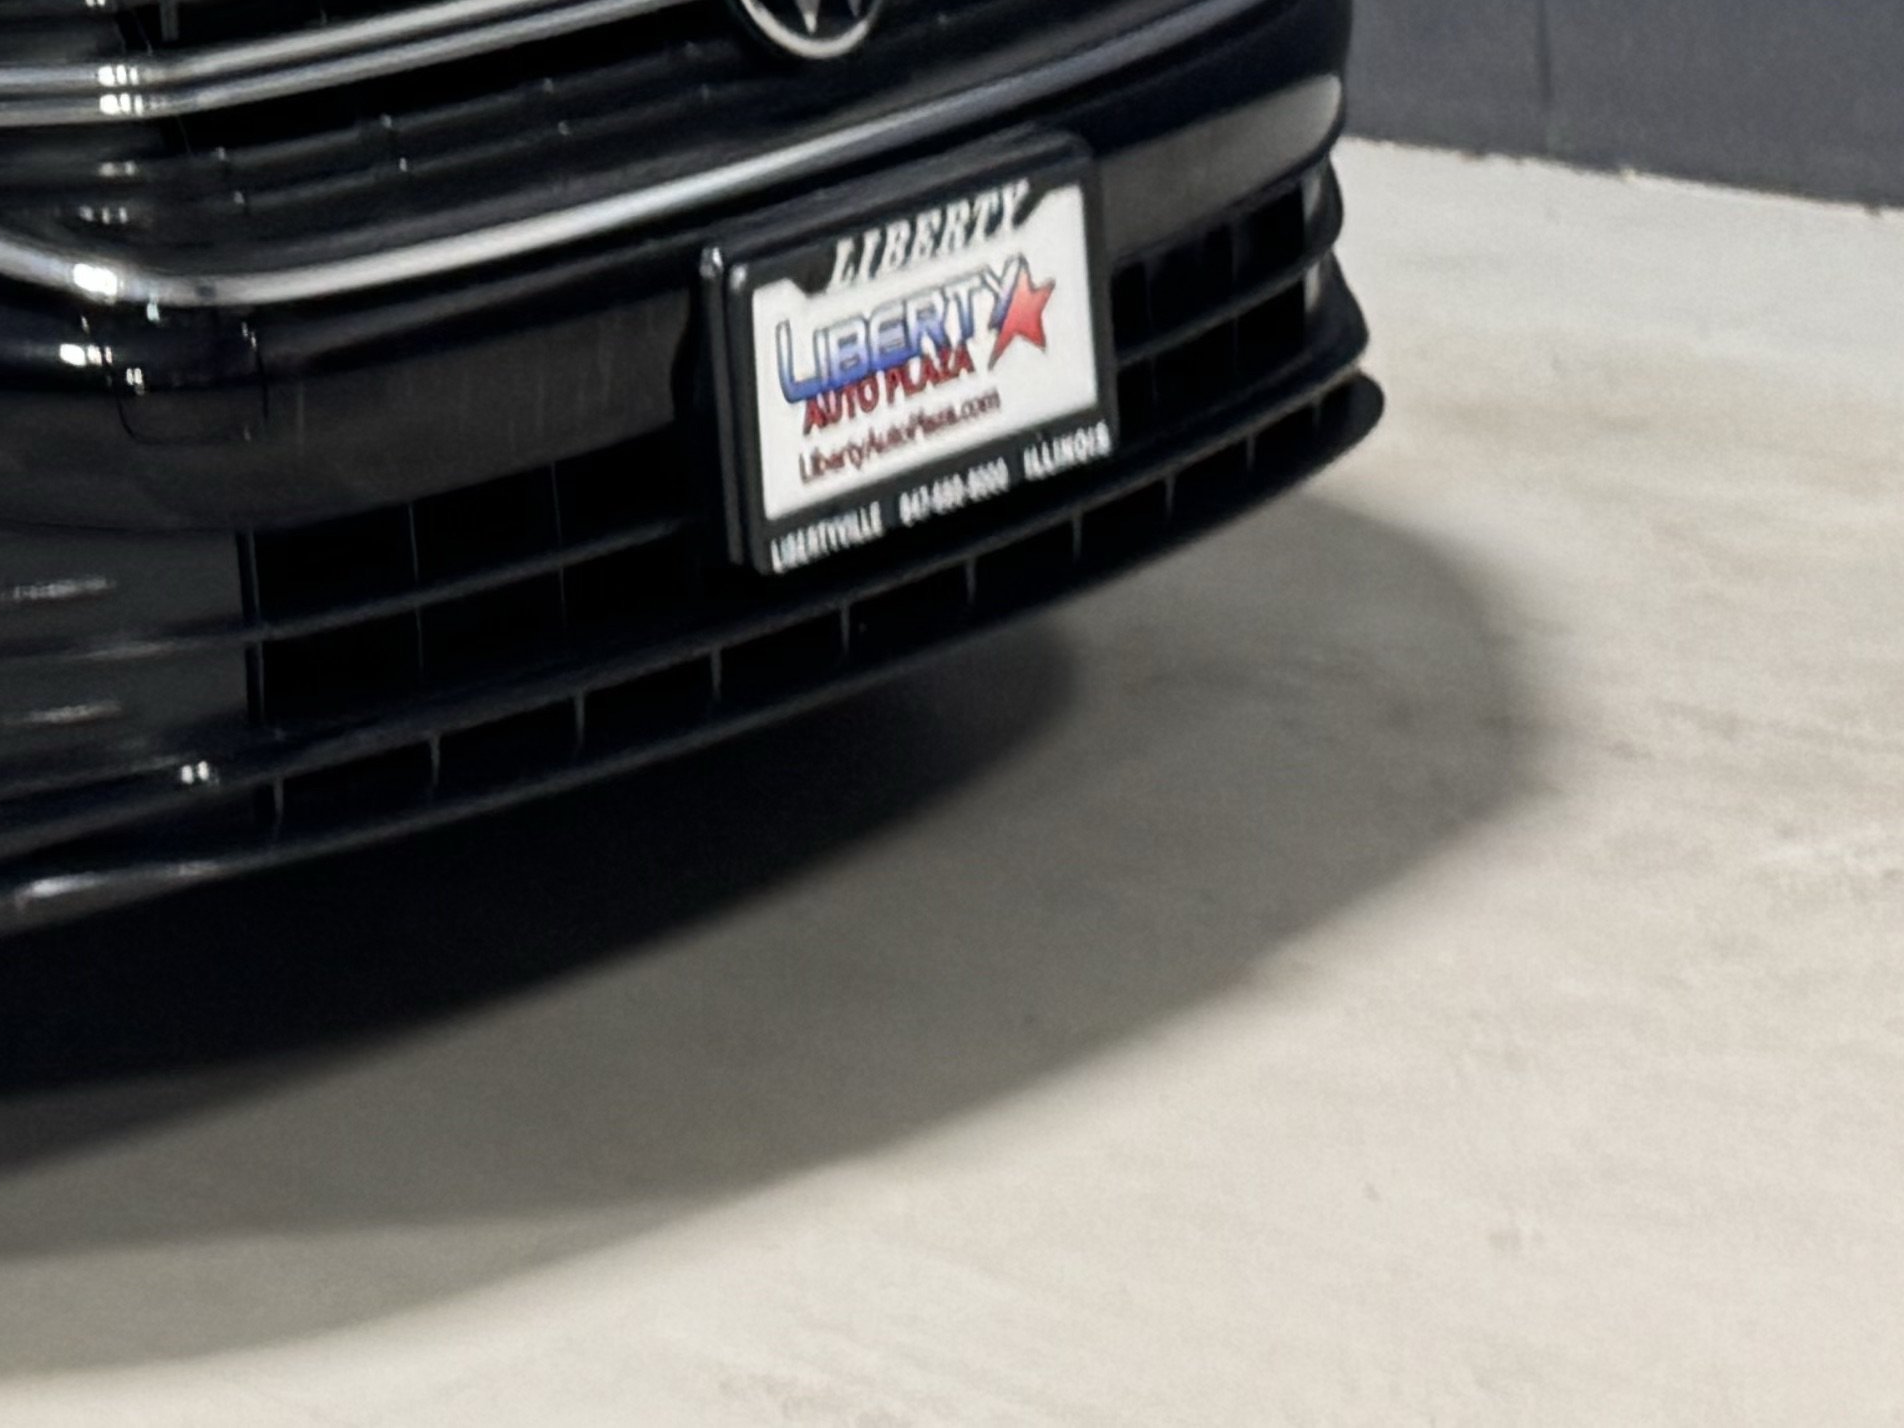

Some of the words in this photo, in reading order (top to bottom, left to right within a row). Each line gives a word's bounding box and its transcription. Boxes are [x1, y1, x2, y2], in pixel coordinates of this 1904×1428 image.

[827, 178, 1031, 293] LIBERTY
[774, 253, 1028, 405] LIBERTY
[803, 369, 881, 437] AUTO
[885, 339, 975, 409] PLAZA
[1024, 419, 1112, 481] ILLINOIS
